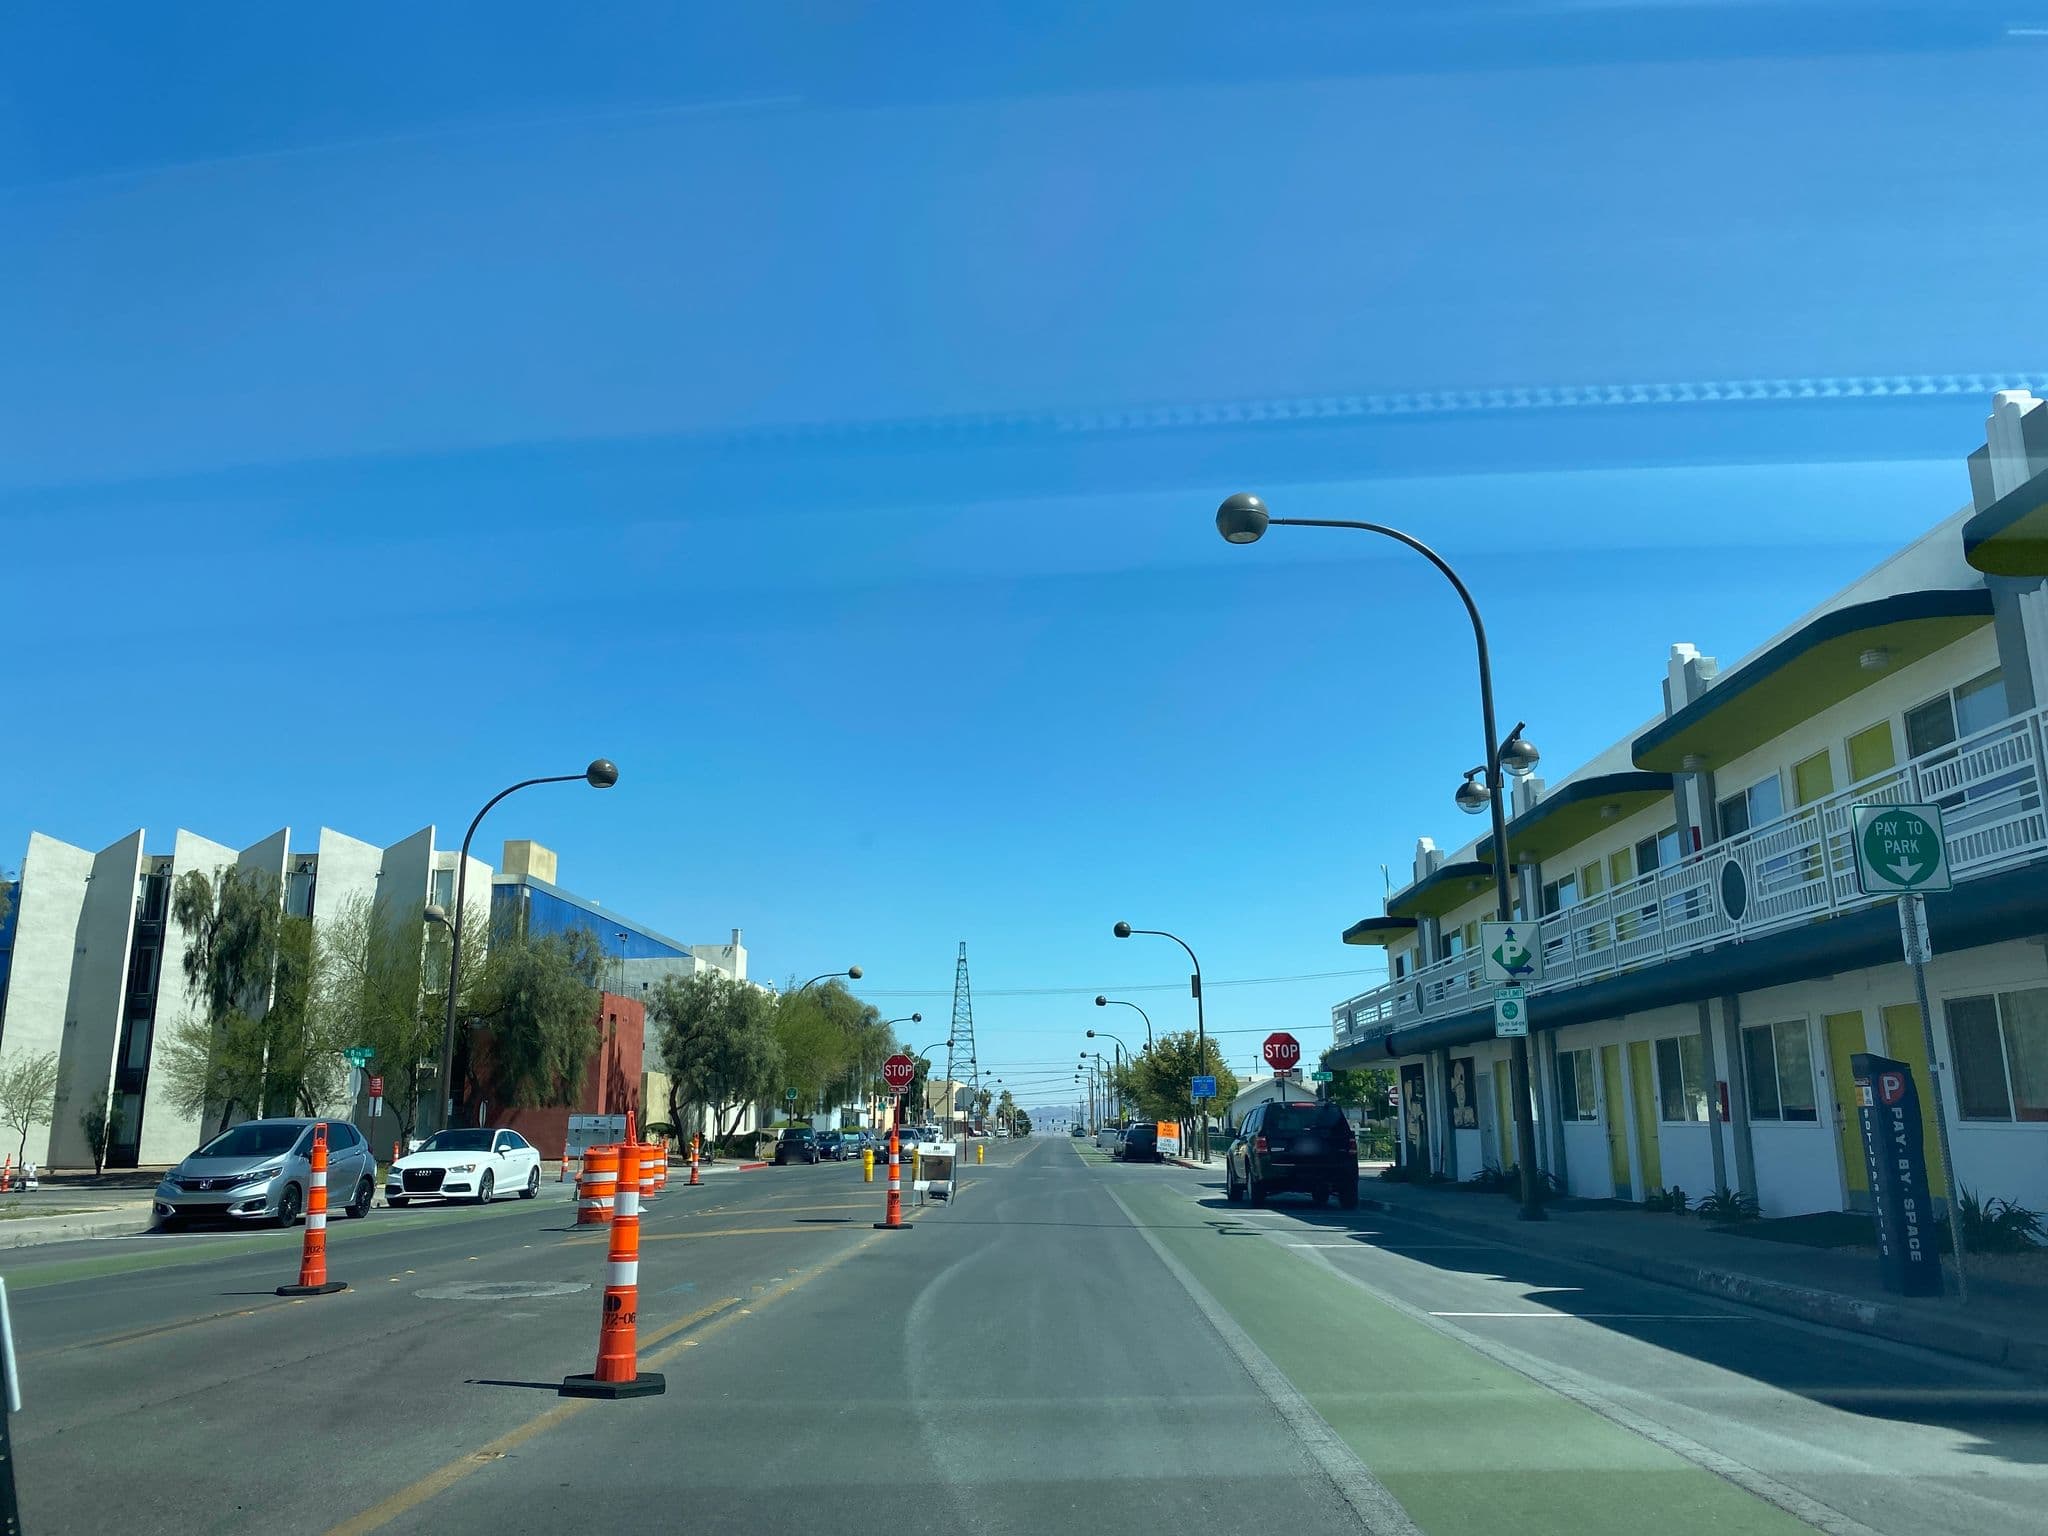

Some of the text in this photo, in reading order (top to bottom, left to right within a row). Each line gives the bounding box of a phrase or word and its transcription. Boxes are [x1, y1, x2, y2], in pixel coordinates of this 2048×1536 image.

[1875, 820, 1923, 836] PAY TO
[1884, 839, 1920, 854] PARK
[1501, 940, 1523, 964] P
[1265, 1044, 1298, 1058] STOP
[884, 1064, 912, 1077] STOP
[1882, 1076, 1900, 1099] P
